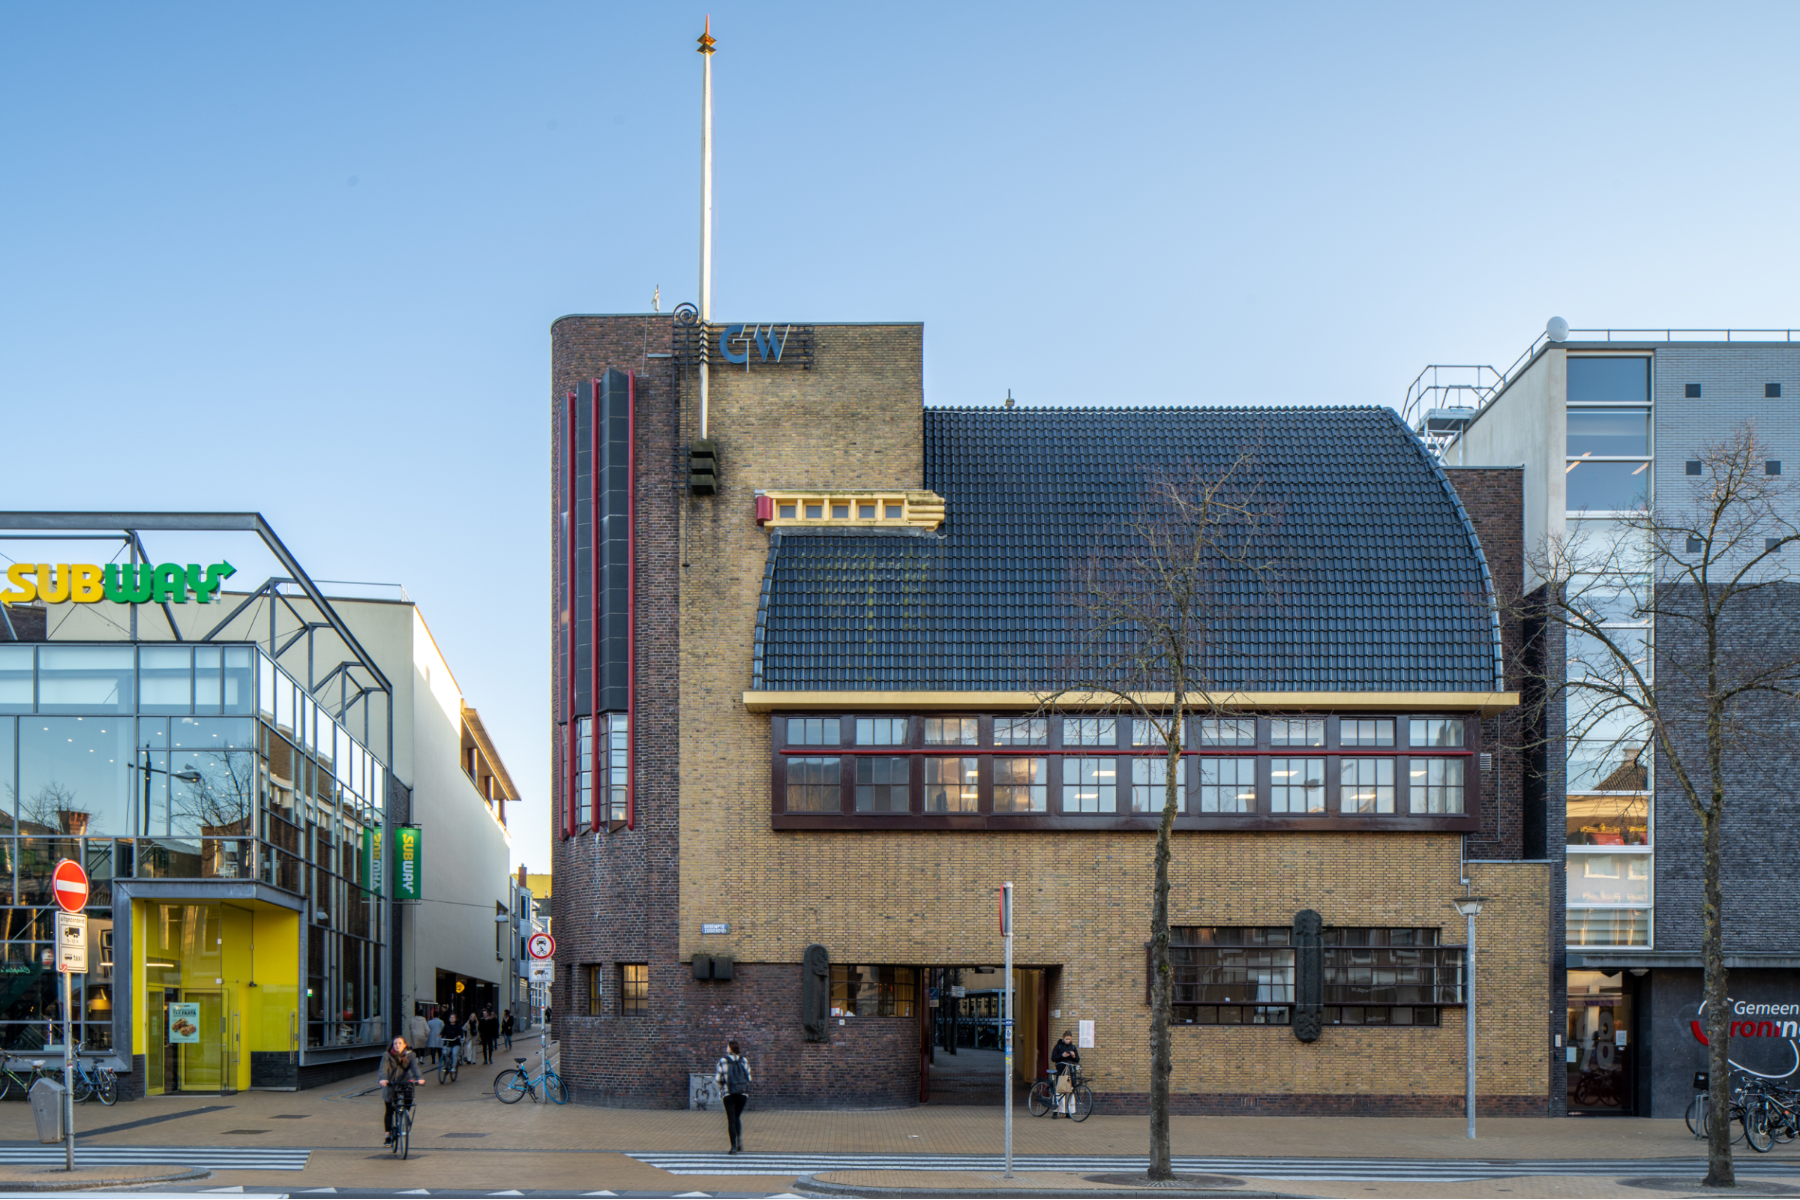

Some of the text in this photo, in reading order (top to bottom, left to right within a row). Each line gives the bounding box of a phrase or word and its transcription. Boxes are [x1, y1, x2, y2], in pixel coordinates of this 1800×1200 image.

[0, 560, 237, 606] SUBWAY
[402, 833, 414, 894] SUBWAY
[1733, 1000, 1800, 1015] Gemeen
